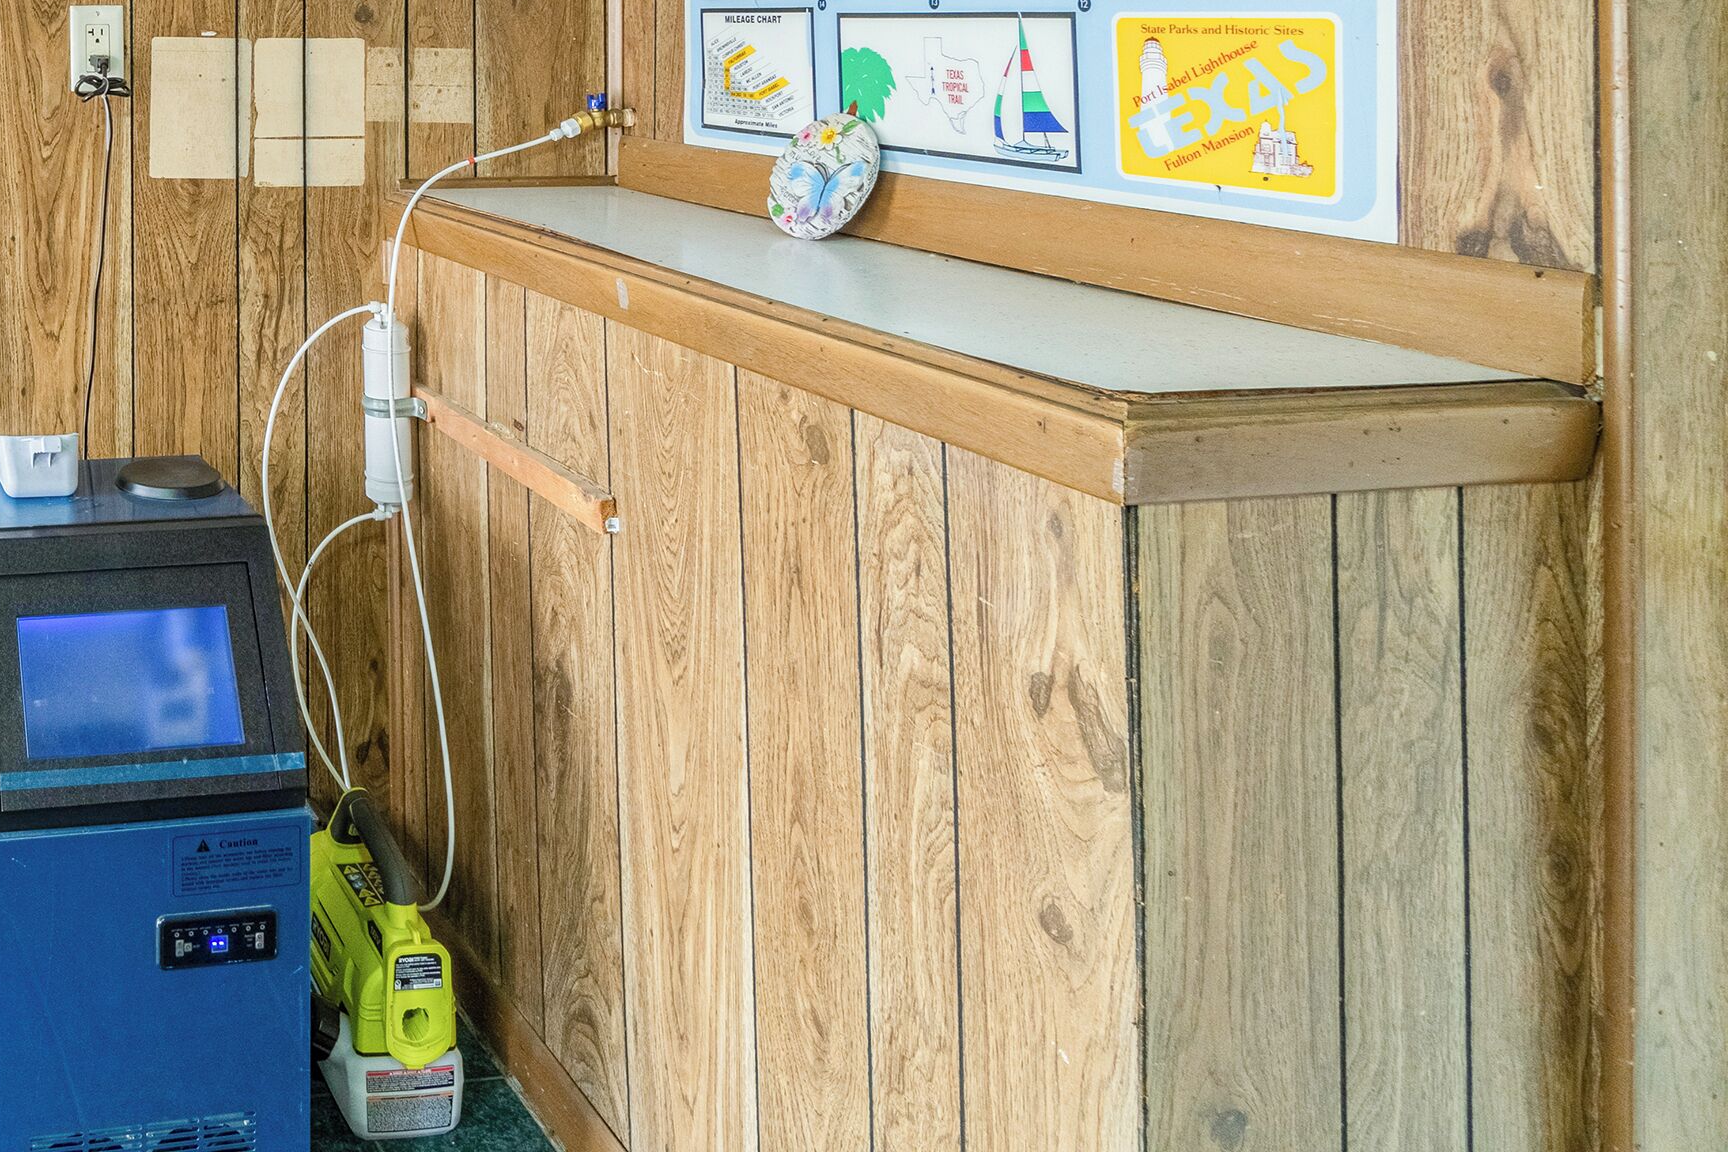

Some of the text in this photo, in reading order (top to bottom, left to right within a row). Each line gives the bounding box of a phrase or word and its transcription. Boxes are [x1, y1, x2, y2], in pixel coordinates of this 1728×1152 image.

[1080, 0, 1089, 8] 12
[1141, 25, 1304, 35] State Parks and Historic Sites
[947, 70, 964, 79] TEXAS
[1133, 40, 1258, 107] Port Isabel Lighthouse
[942, 82, 968, 92] TROPICAL
[949, 95, 964, 104] TRAIL
[1128, 39, 1327, 158] TEXAS
[735, 119, 763, 127] Approximate
[1164, 126, 1254, 171] Fulton Mansion
[220, 838, 258, 849] Caution
